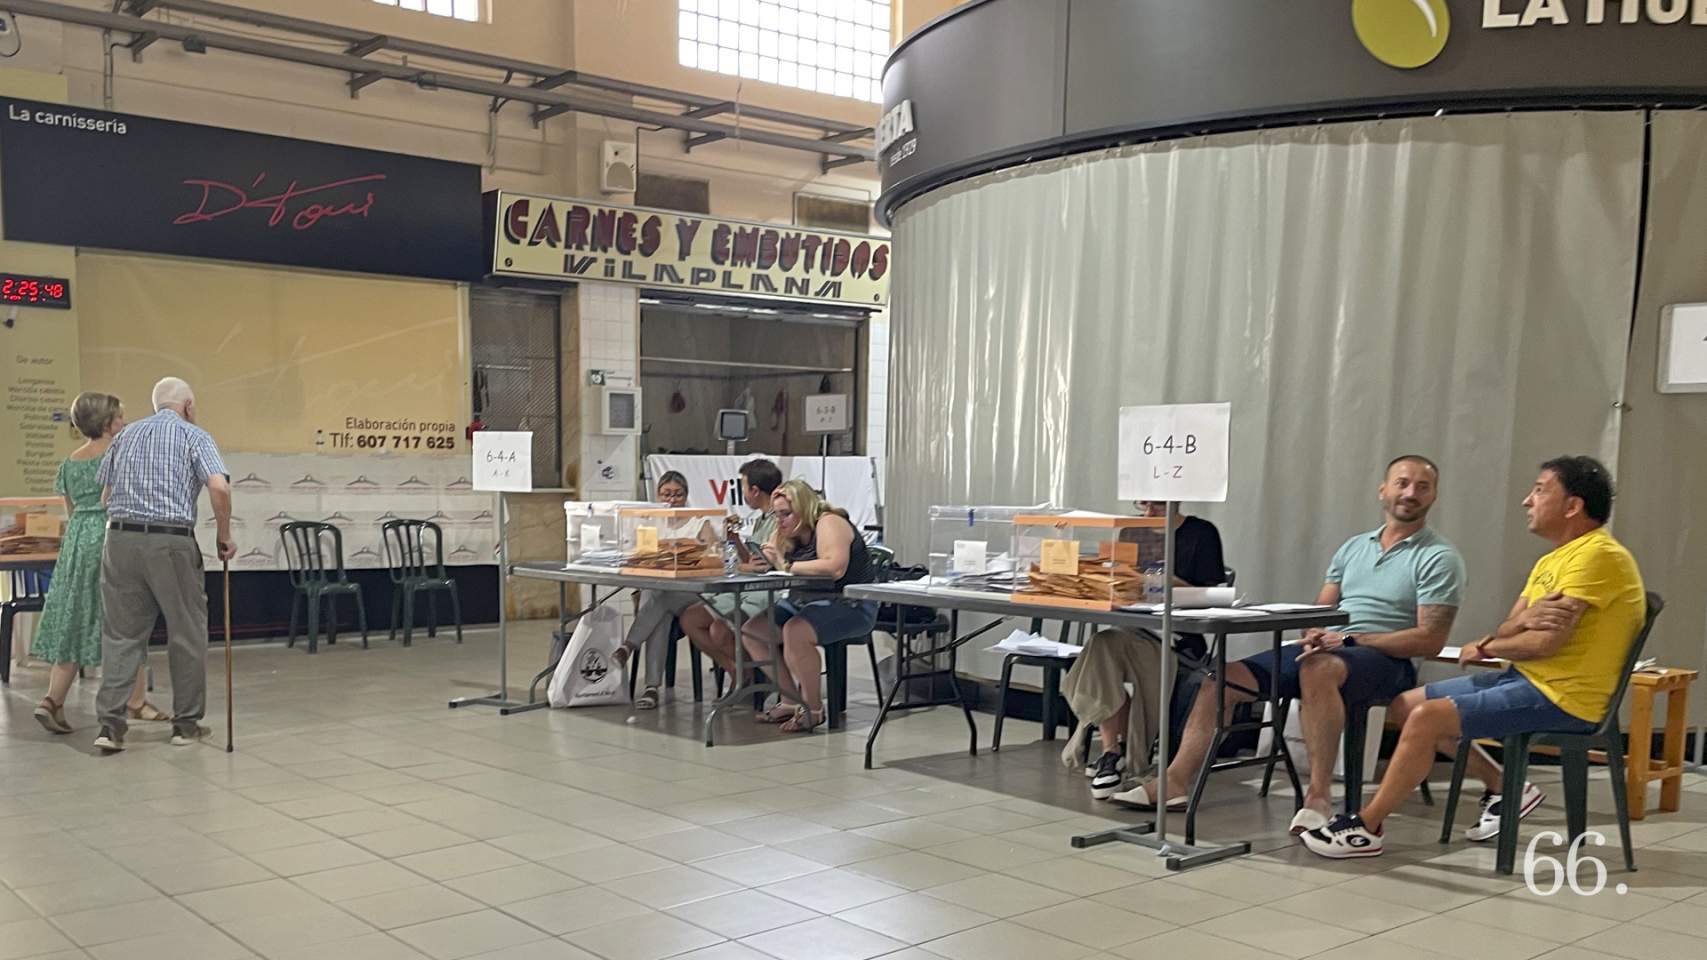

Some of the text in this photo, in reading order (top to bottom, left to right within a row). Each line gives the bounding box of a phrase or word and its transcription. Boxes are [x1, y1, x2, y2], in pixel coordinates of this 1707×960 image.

[1482, 0, 1569, 28] LA
[9, 104, 30, 121] La
[504, 199, 889, 281] CARNES Y EMBUTIDOS
[345, 417, 456, 434] Elaboración propia
[356, 435, 387, 449] 607
[392, 436, 420, 449] 717
[426, 436, 455, 449] 625
[1143, 434, 1197, 455] 6-4-B
[708, 478, 744, 506] Vil
